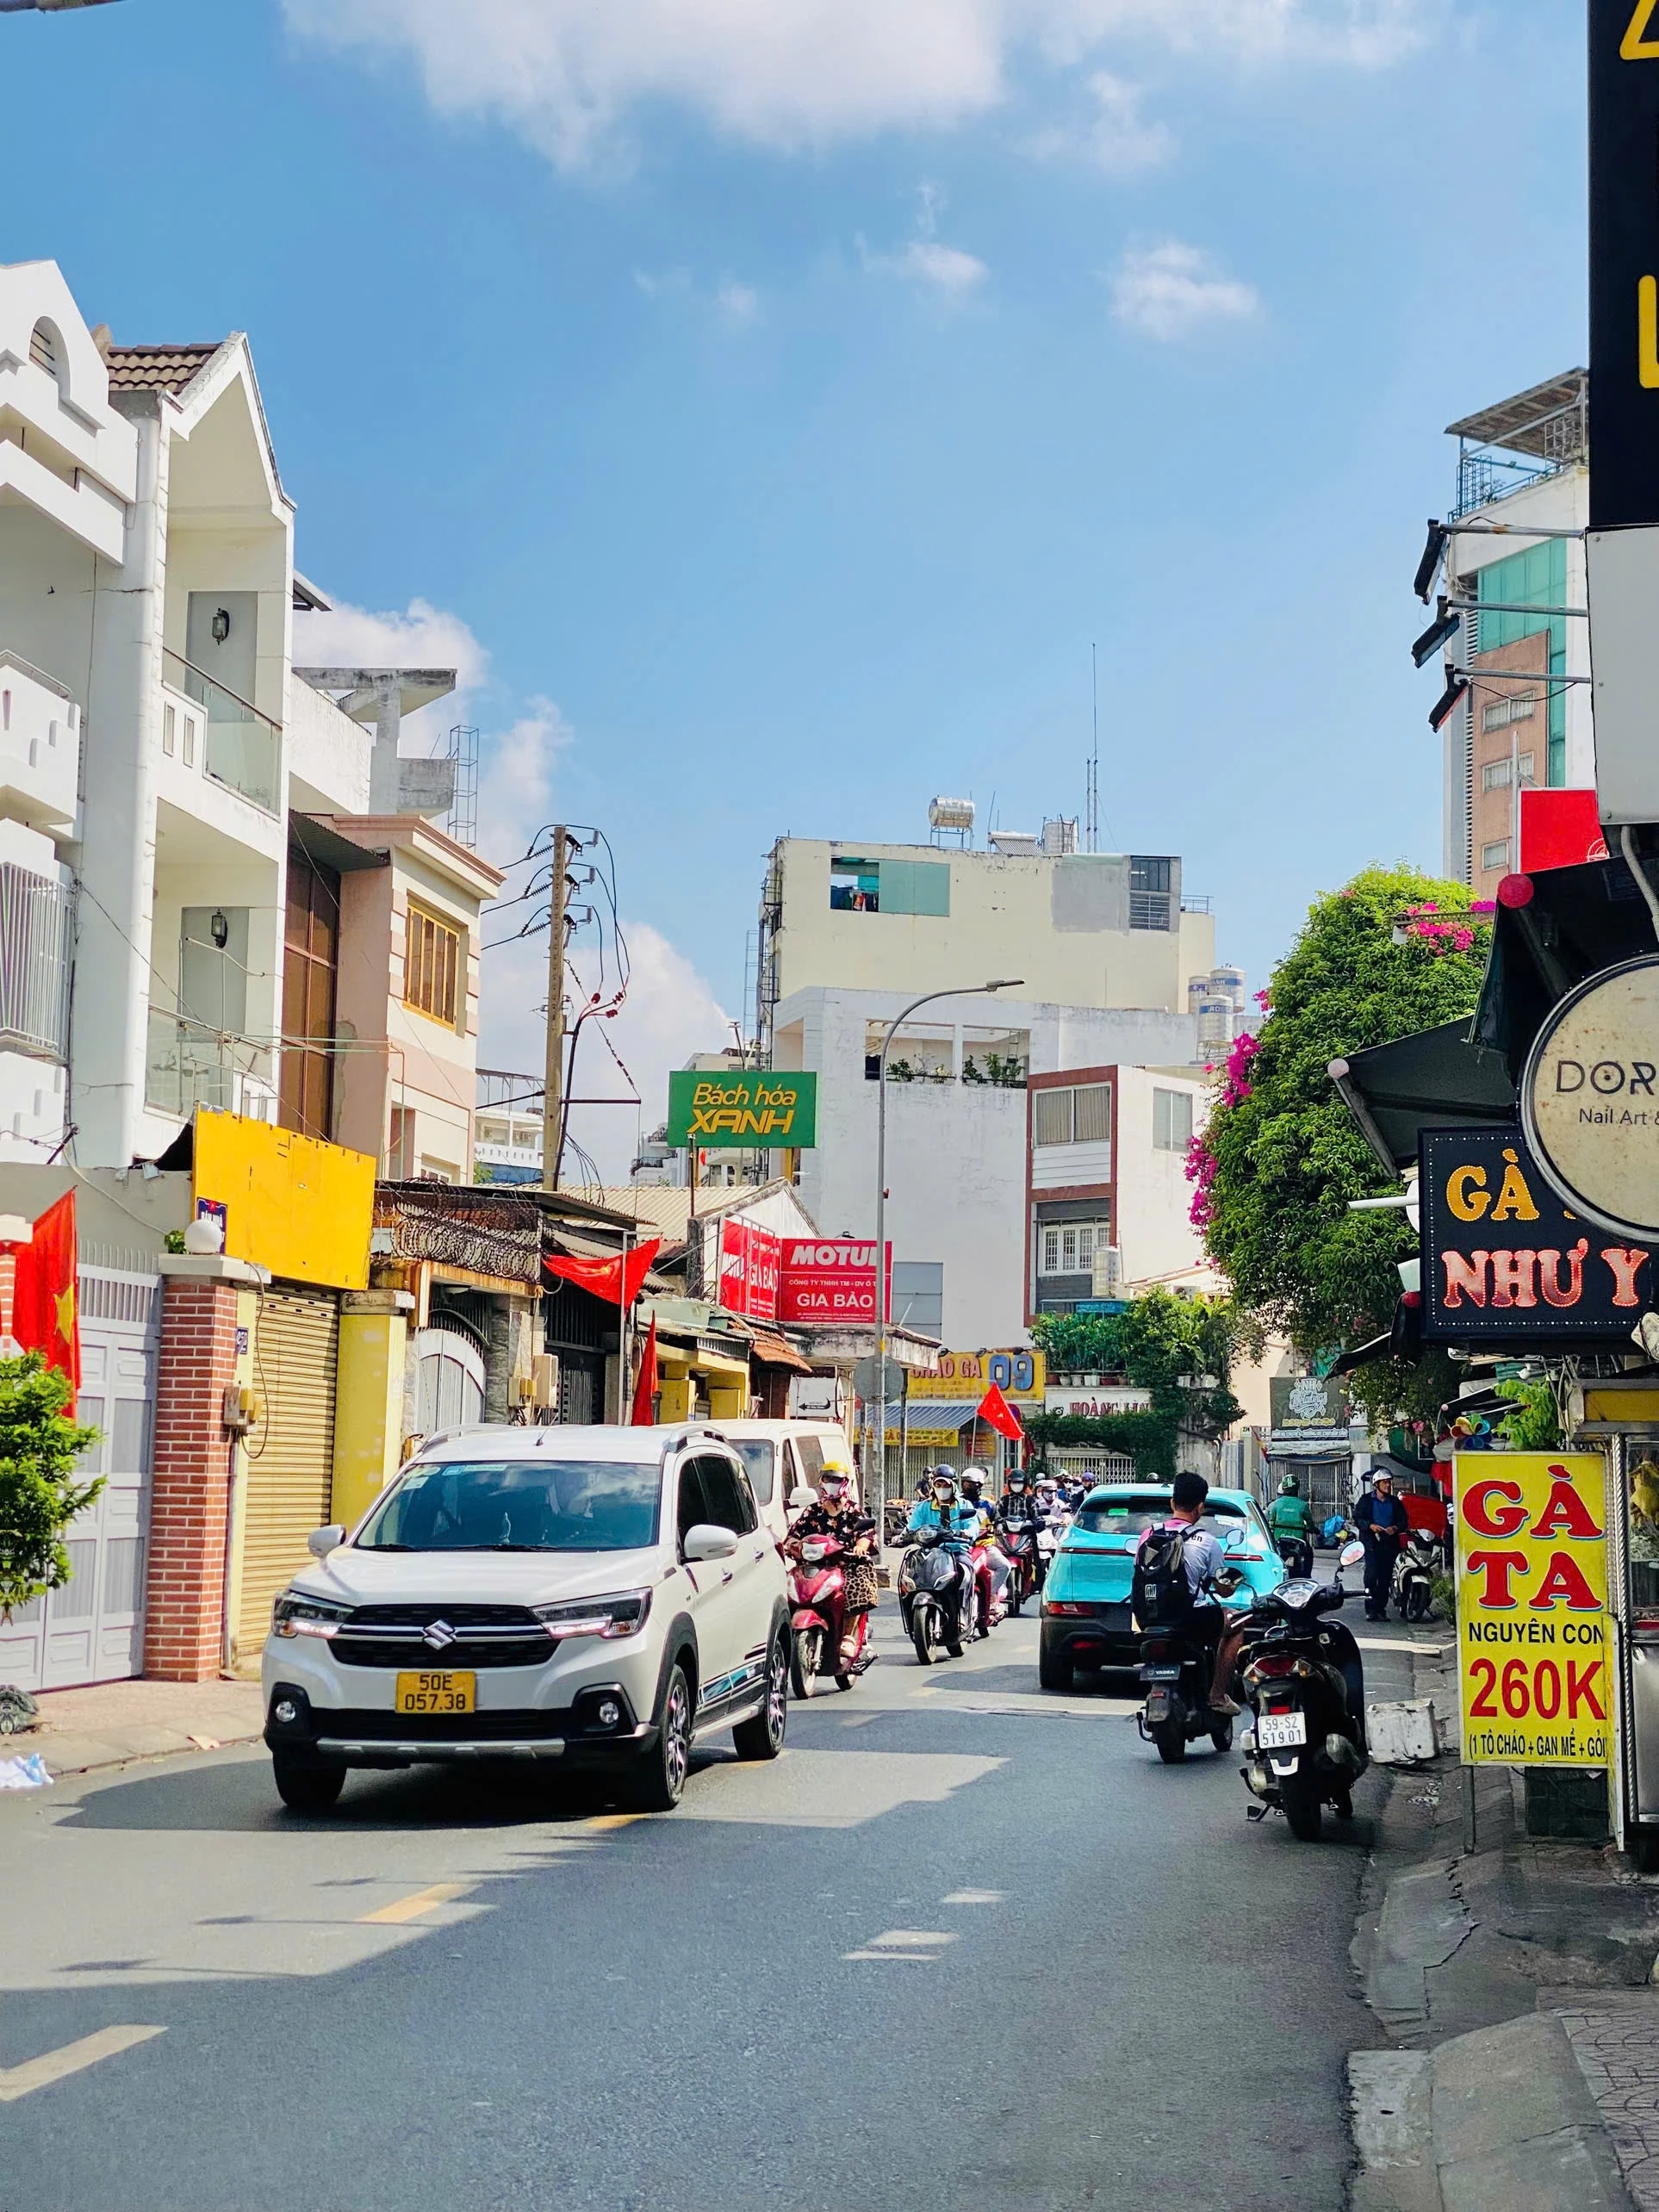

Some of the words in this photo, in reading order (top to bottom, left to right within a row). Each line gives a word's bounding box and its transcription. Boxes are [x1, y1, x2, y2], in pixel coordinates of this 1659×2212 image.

[693, 1083, 749, 1105] Bách
[755, 1083, 797, 1105] hóa
[687, 1109, 794, 1134] XANH
[1579, 1108, 1612, 1124] Nail
[1619, 1109, 1648, 1125] Art
[1446, 1148, 1539, 1221] GÀ
[1441, 1238, 1589, 1308] NHƯ
[797, 1294, 828, 1307] GIA
[989, 1354, 1034, 1390] 09
[1462, 1464, 1605, 1540] GÀ
[1467, 1550, 1604, 1612] TA
[1469, 1618, 1555, 1643] NGUYÊN
[1563, 1624, 1605, 1644] CON
[419, 1674, 453, 1691] 50E
[1469, 1657, 1606, 1720] 260K
[405, 1693, 466, 1710] 057.38
[1265, 1716, 1298, 1731] 59-S2
[1263, 1730, 1302, 1745] 519.01
[1469, 1734, 1477, 1759] (1
[1481, 1730, 1494, 1755] TÔ
[1497, 1730, 1525, 1755] CHÁO
[1537, 1737, 1557, 1756] GAN
[1588, 1729, 1607, 1757] GỎI
